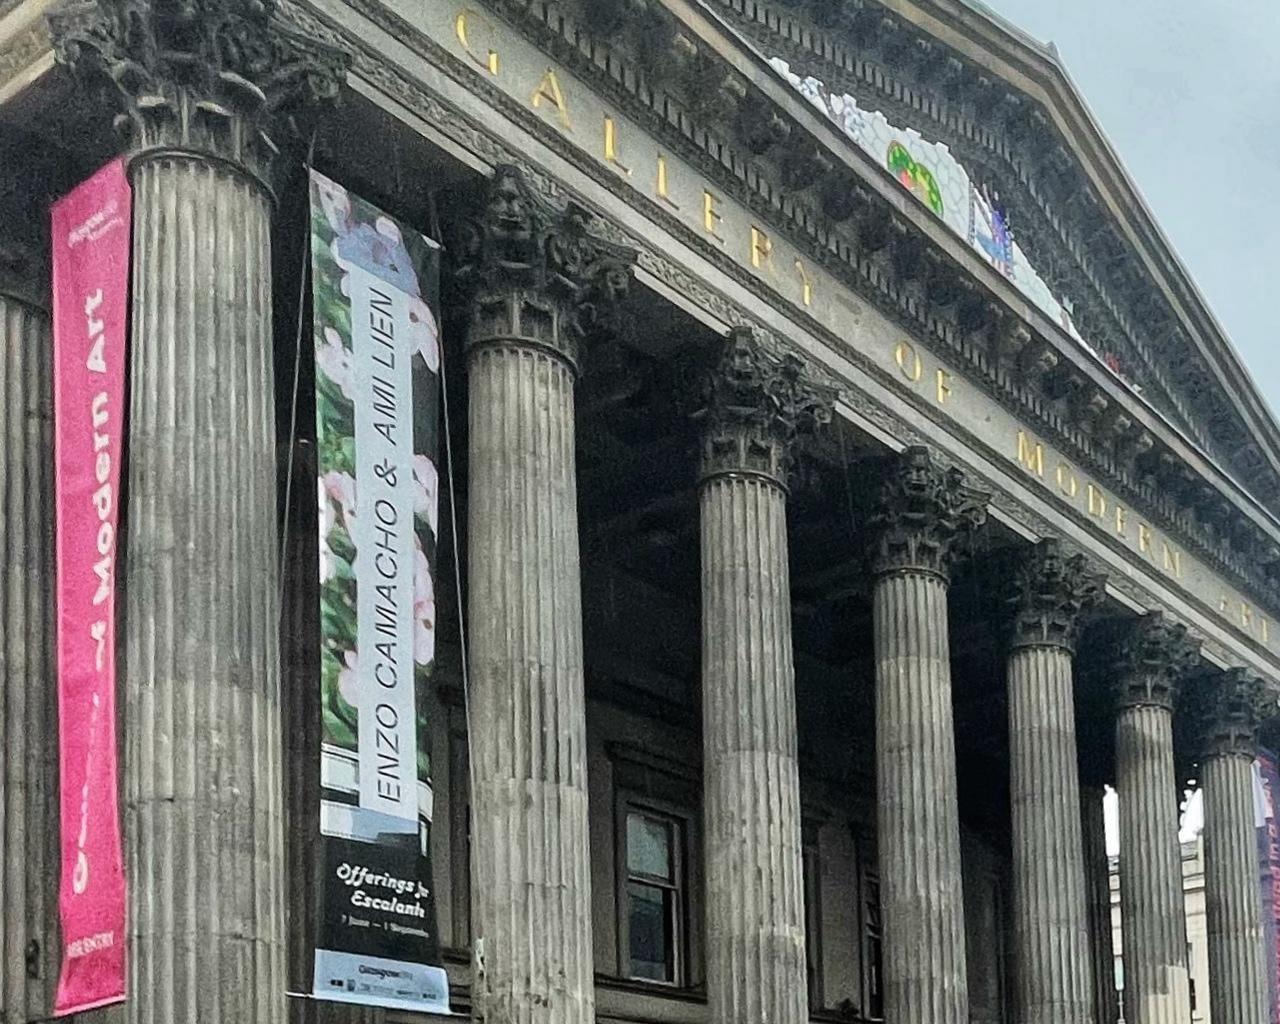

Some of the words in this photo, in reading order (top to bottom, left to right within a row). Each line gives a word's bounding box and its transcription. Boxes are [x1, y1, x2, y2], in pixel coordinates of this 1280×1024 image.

[85, 288, 107, 374] Art
[368, 286, 396, 370] LIEN
[456, 9, 812, 305] GALLERY
[895, 340, 953, 403] OF
[1017, 431, 1180, 577] MODERN
[371, 376, 397, 447] AMI
[92, 391, 114, 606] Modern
[373, 458, 397, 488] &
[374, 499, 399, 689] CAMACHO
[376, 704, 401, 803] ENZO
[336, 862, 415, 894] Offerings
